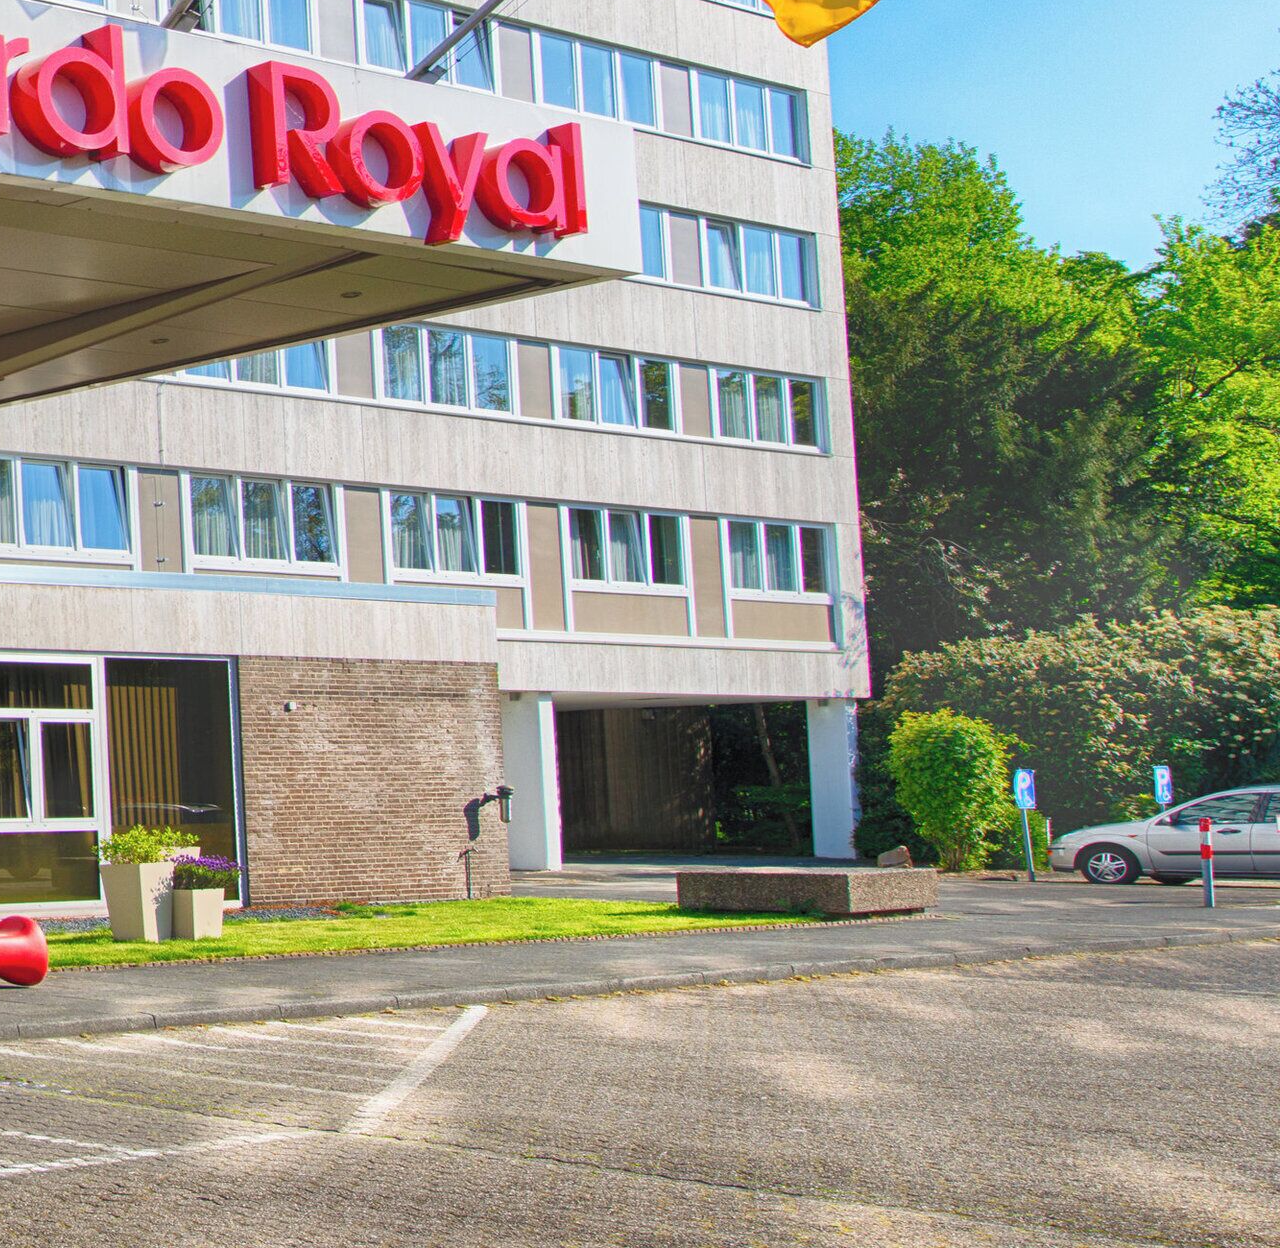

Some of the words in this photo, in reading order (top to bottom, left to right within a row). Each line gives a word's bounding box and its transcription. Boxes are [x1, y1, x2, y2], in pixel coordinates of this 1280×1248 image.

[247, 59, 589, 246] Royal
[1018, 771, 1031, 800] P
[1156, 768, 1170, 796] P
